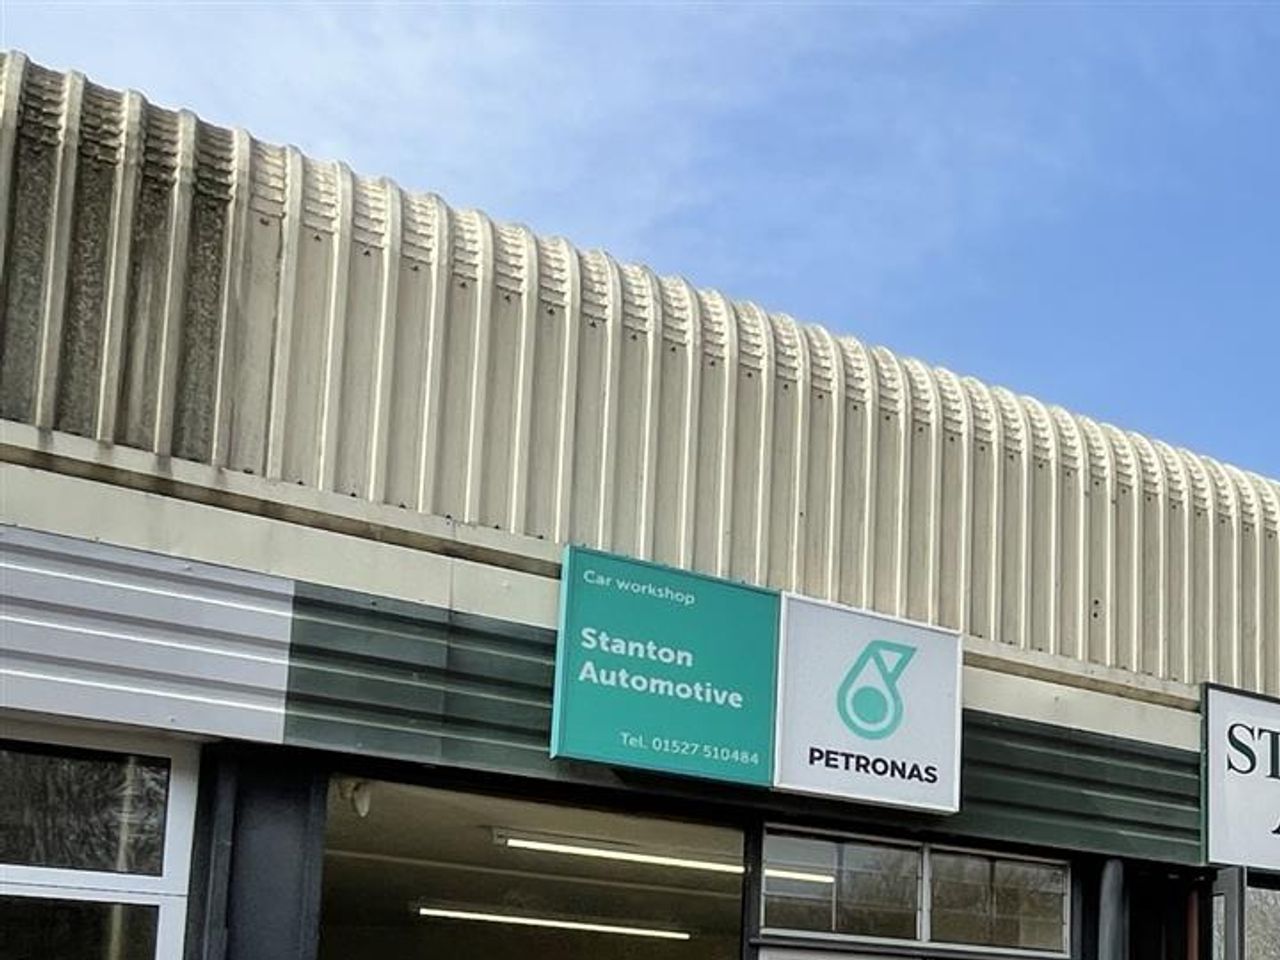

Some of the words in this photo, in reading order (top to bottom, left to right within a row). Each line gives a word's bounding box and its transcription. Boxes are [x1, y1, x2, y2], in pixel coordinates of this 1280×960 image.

[583, 569, 613, 587] Car
[616, 578, 696, 606] workshop
[580, 627, 693, 667] Stanton
[578, 660, 744, 709] Automotive
[620, 731, 648, 751] Tel.
[652, 736, 698, 757] 01527
[702, 742, 759, 765] 510484
[808, 746, 938, 784] PETRONAS
